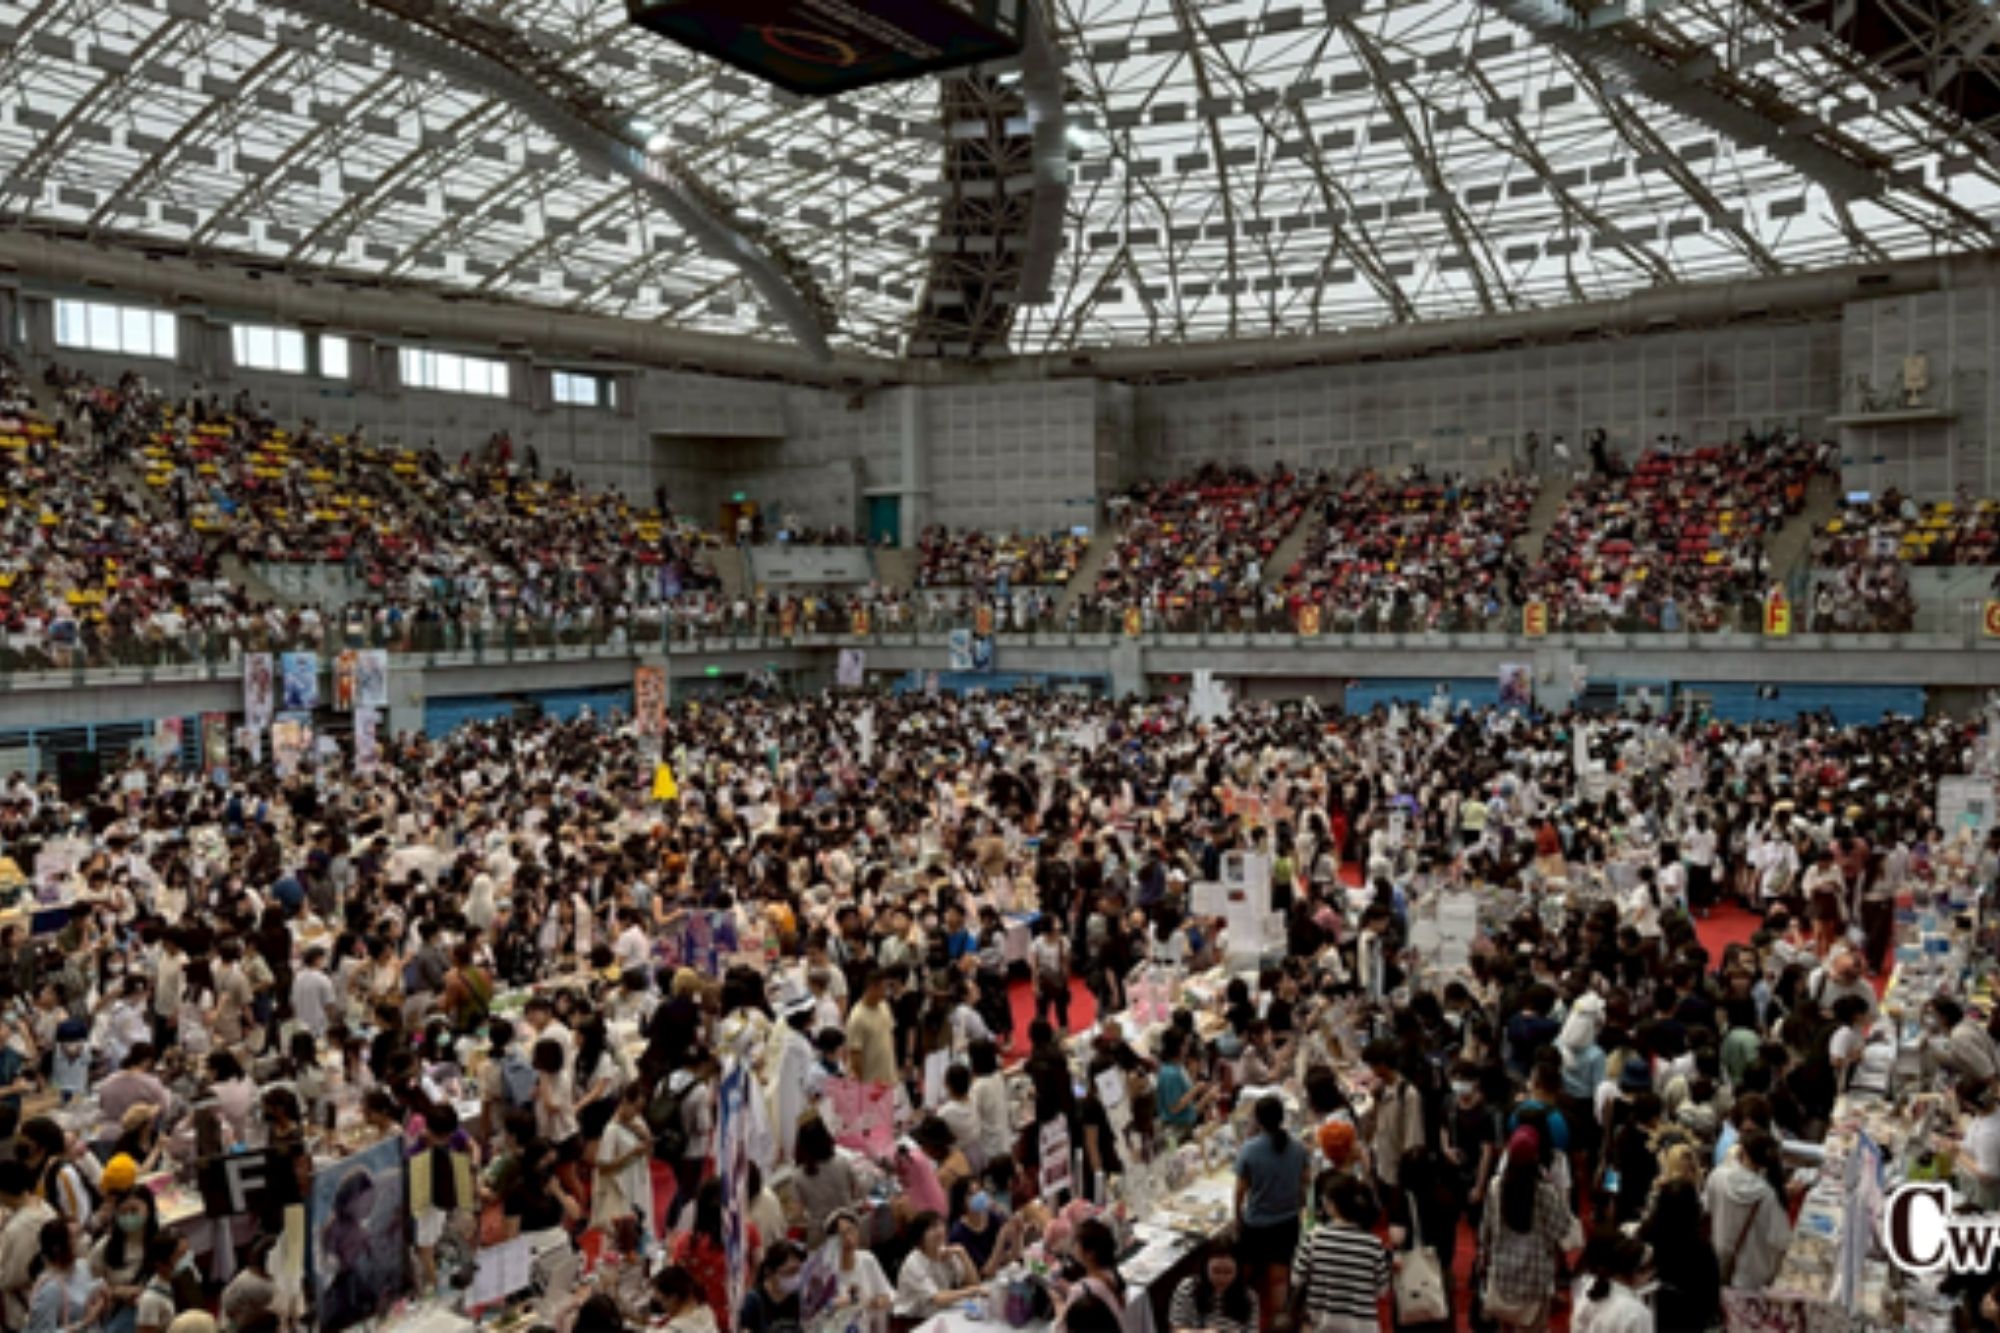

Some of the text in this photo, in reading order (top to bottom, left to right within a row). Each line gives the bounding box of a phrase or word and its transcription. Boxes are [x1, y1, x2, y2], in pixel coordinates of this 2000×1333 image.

[1528, 604, 1544, 634] E
[1767, 603, 1786, 631] F
[225, 1155, 266, 1211] F
